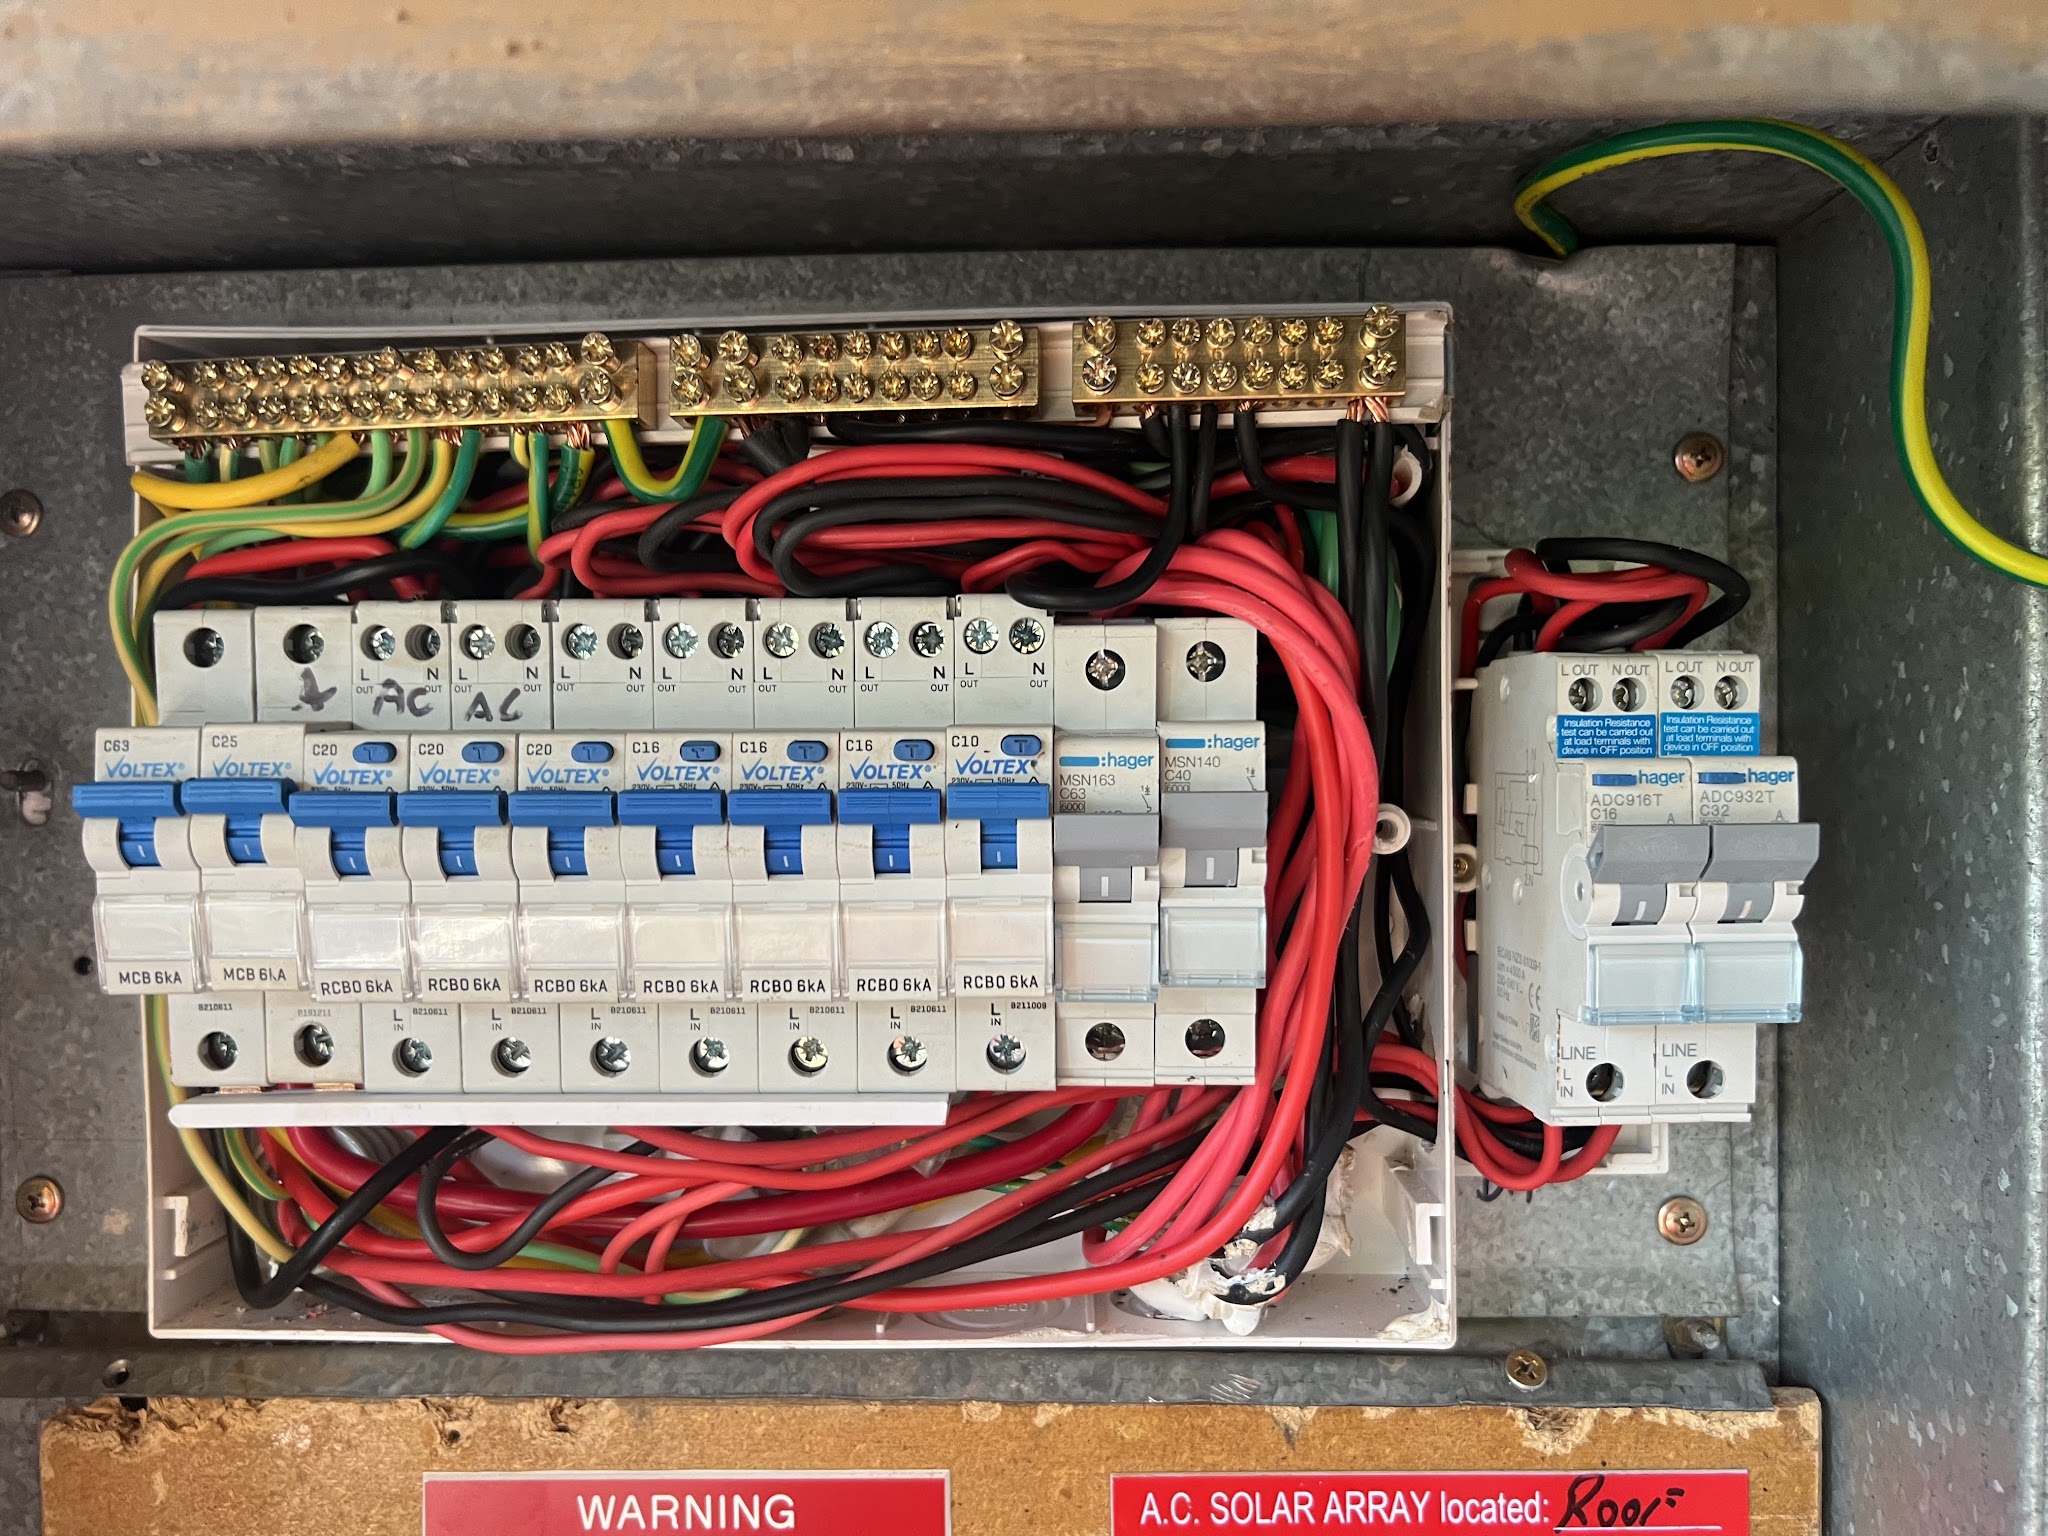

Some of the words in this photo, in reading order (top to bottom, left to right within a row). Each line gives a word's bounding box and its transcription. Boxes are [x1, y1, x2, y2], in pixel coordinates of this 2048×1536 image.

[561, 667, 570, 678] L
[866, 667, 874, 678] L
[934, 666, 945, 678] N
[965, 663, 974, 674] L
[1033, 663, 1045, 674] N
[1561, 665, 1569, 676] L
[1573, 664, 1599, 676] OUT
[1612, 664, 1621, 675] N
[1625, 664, 1649, 675] OUT
[1666, 662, 1673, 673] L
[1676, 661, 1703, 673] OUT
[1716, 661, 1725, 672] N
[1729, 661, 1754, 672] OUT
[361, 669, 370, 680] L
[428, 668, 439, 680] N
[459, 668, 468, 680] L
[527, 667, 538, 679] N
[630, 667, 641, 679] N
[663, 667, 672, 679] L
[732, 668, 743, 680] N
[764, 667, 772, 679] L
[832, 668, 844, 680] N
[356, 686, 374, 694] OUT
[455, 685, 472, 693] OUT
[728, 685, 746, 693] OUT
[759, 685, 776, 693] OUT
[861, 684, 878, 692] OUT
[931, 684, 949, 692] OUT
[961, 680, 978, 688] OUT
[1030, 680, 1048, 688] OUT
[373, 678, 433, 717] AC
[1564, 719, 1602, 727] Insulation
[1605, 719, 1650, 727] Resistance
[1667, 716, 1704, 724] Insulation
[1707, 716, 1751, 724] Resistance
[1561, 728, 1577, 736] test
[1596, 728, 1606, 736] be
[1609, 728, 1636, 736] carried
[1663, 725, 1679, 733] test
[1698, 725, 1708, 733] be
[1711, 725, 1738, 733] carried
[212, 736, 238, 748] C25
[952, 736, 978, 747] C10
[1574, 737, 1592, 745] load
[1594, 737, 1631, 745] terminals
[1666, 734, 1674, 742] at
[1676, 734, 1693, 742] load
[1696, 734, 1732, 742] terminals
[1734, 734, 1751, 742] with
[104, 740, 129, 751] C63
[313, 744, 337, 756] C20
[419, 744, 444, 755] C20
[527, 744, 552, 756] C20
[632, 742, 659, 754] C16
[740, 742, 767, 753] C16
[846, 740, 872, 752] C16
[1562, 746, 1588, 754] device
[1591, 746, 1597, 754] in
[1600, 746, 1617, 754] OFF
[1620, 746, 1652, 756] position
[1664, 743, 1690, 751] device
[1692, 743, 1699, 751] in
[1721, 744, 1753, 753] position
[1165, 756, 1221, 768] MSN140
[1060, 775, 1115, 787] MSN163
[1165, 770, 1191, 781] C40
[1639, 770, 1684, 786] hager
[1748, 769, 1795, 785] hager
[1060, 789, 1086, 800] C63
[1591, 794, 1662, 806] ADC916T
[1701, 791, 1774, 803] ADC932T
[1060, 803, 1084, 812] 6000
[1701, 806, 1729, 816] C32
[1591, 809, 1617, 819] C16
[120, 971, 150, 984] MCB
[155, 971, 182, 984] 6kA
[224, 968, 255, 981] MCB
[321, 981, 361, 995] RCBO
[366, 980, 393, 993] 6kA
[428, 978, 468, 991] RCBO
[474, 978, 501, 991] 6kA
[535, 980, 575, 992] RCBO
[580, 980, 607, 992] 6kA
[644, 980, 686, 993] RCBO
[691, 980, 718, 993] 6kA
[750, 980, 792, 993] RCBO
[797, 980, 825, 992] 6kA
[857, 979, 898, 991] RCBO
[903, 979, 931, 991] 6kA
[964, 976, 1004, 989] RCBO
[1010, 975, 1038, 988] 6kA
[394, 1009, 403, 1021] L
[492, 1009, 501, 1020] L
[591, 1008, 600, 1019] L
[691, 1008, 700, 1020] L
[790, 1008, 799, 1019] L
[891, 1007, 900, 1019] L
[991, 1003, 1000, 1015] L
[492, 1023, 502, 1031] IN
[991, 1018, 1001, 1026] IN
[1561, 1046, 1596, 1060] LINE
[1663, 1043, 1697, 1057] LINE
[1563, 1069, 1571, 1080] L
[1665, 1066, 1672, 1077] L
[1561, 1086, 1573, 1098] IN
[1662, 1084, 1674, 1094] IN
[576, 1493, 795, 1529] WARNING
[1140, 1493, 1199, 1525] A.C.
[1209, 1491, 1315, 1524] SOLAR
[1323, 1490, 1433, 1524] ARRAY
[1440, 1490, 1549, 1524] located:
